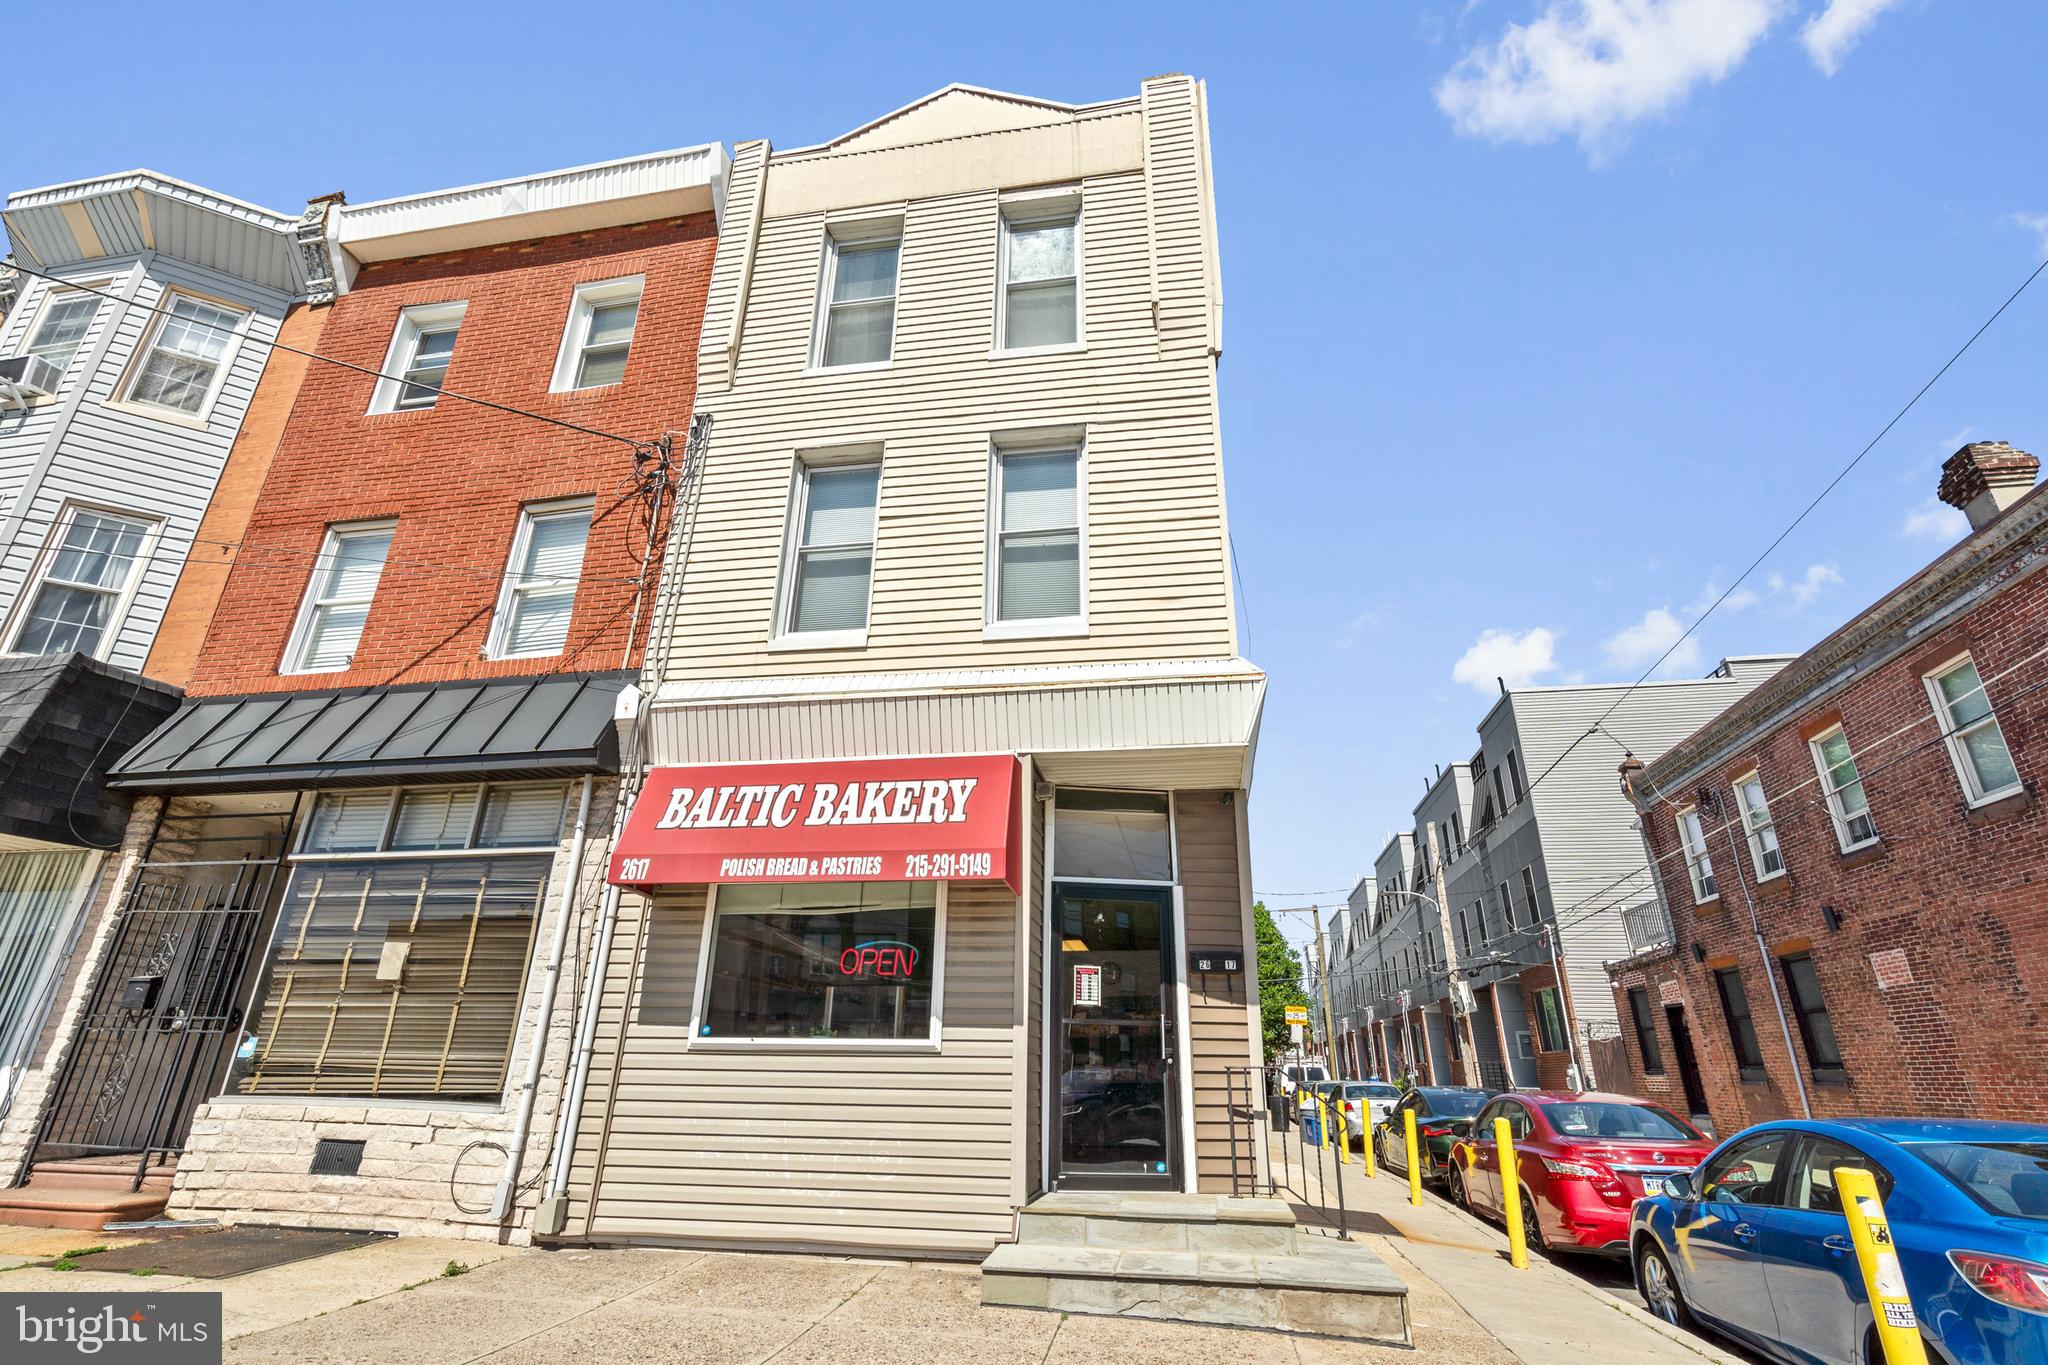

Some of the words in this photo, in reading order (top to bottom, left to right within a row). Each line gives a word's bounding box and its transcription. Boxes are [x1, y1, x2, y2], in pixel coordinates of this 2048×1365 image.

[655, 783, 805, 830] BALTIC
[803, 777, 978, 826] BAKERY
[619, 858, 651, 880] 2617
[720, 858, 765, 877] POLISH
[766, 857, 808, 876] BREAD
[809, 859, 819, 876] &
[820, 856, 883, 876] PASTRIES
[905, 852, 991, 878] 215-291-9149
[840, 947, 915, 976] OPEN
[1200, 960, 1210, 969] 26
[1225, 960, 1236, 970] 17
